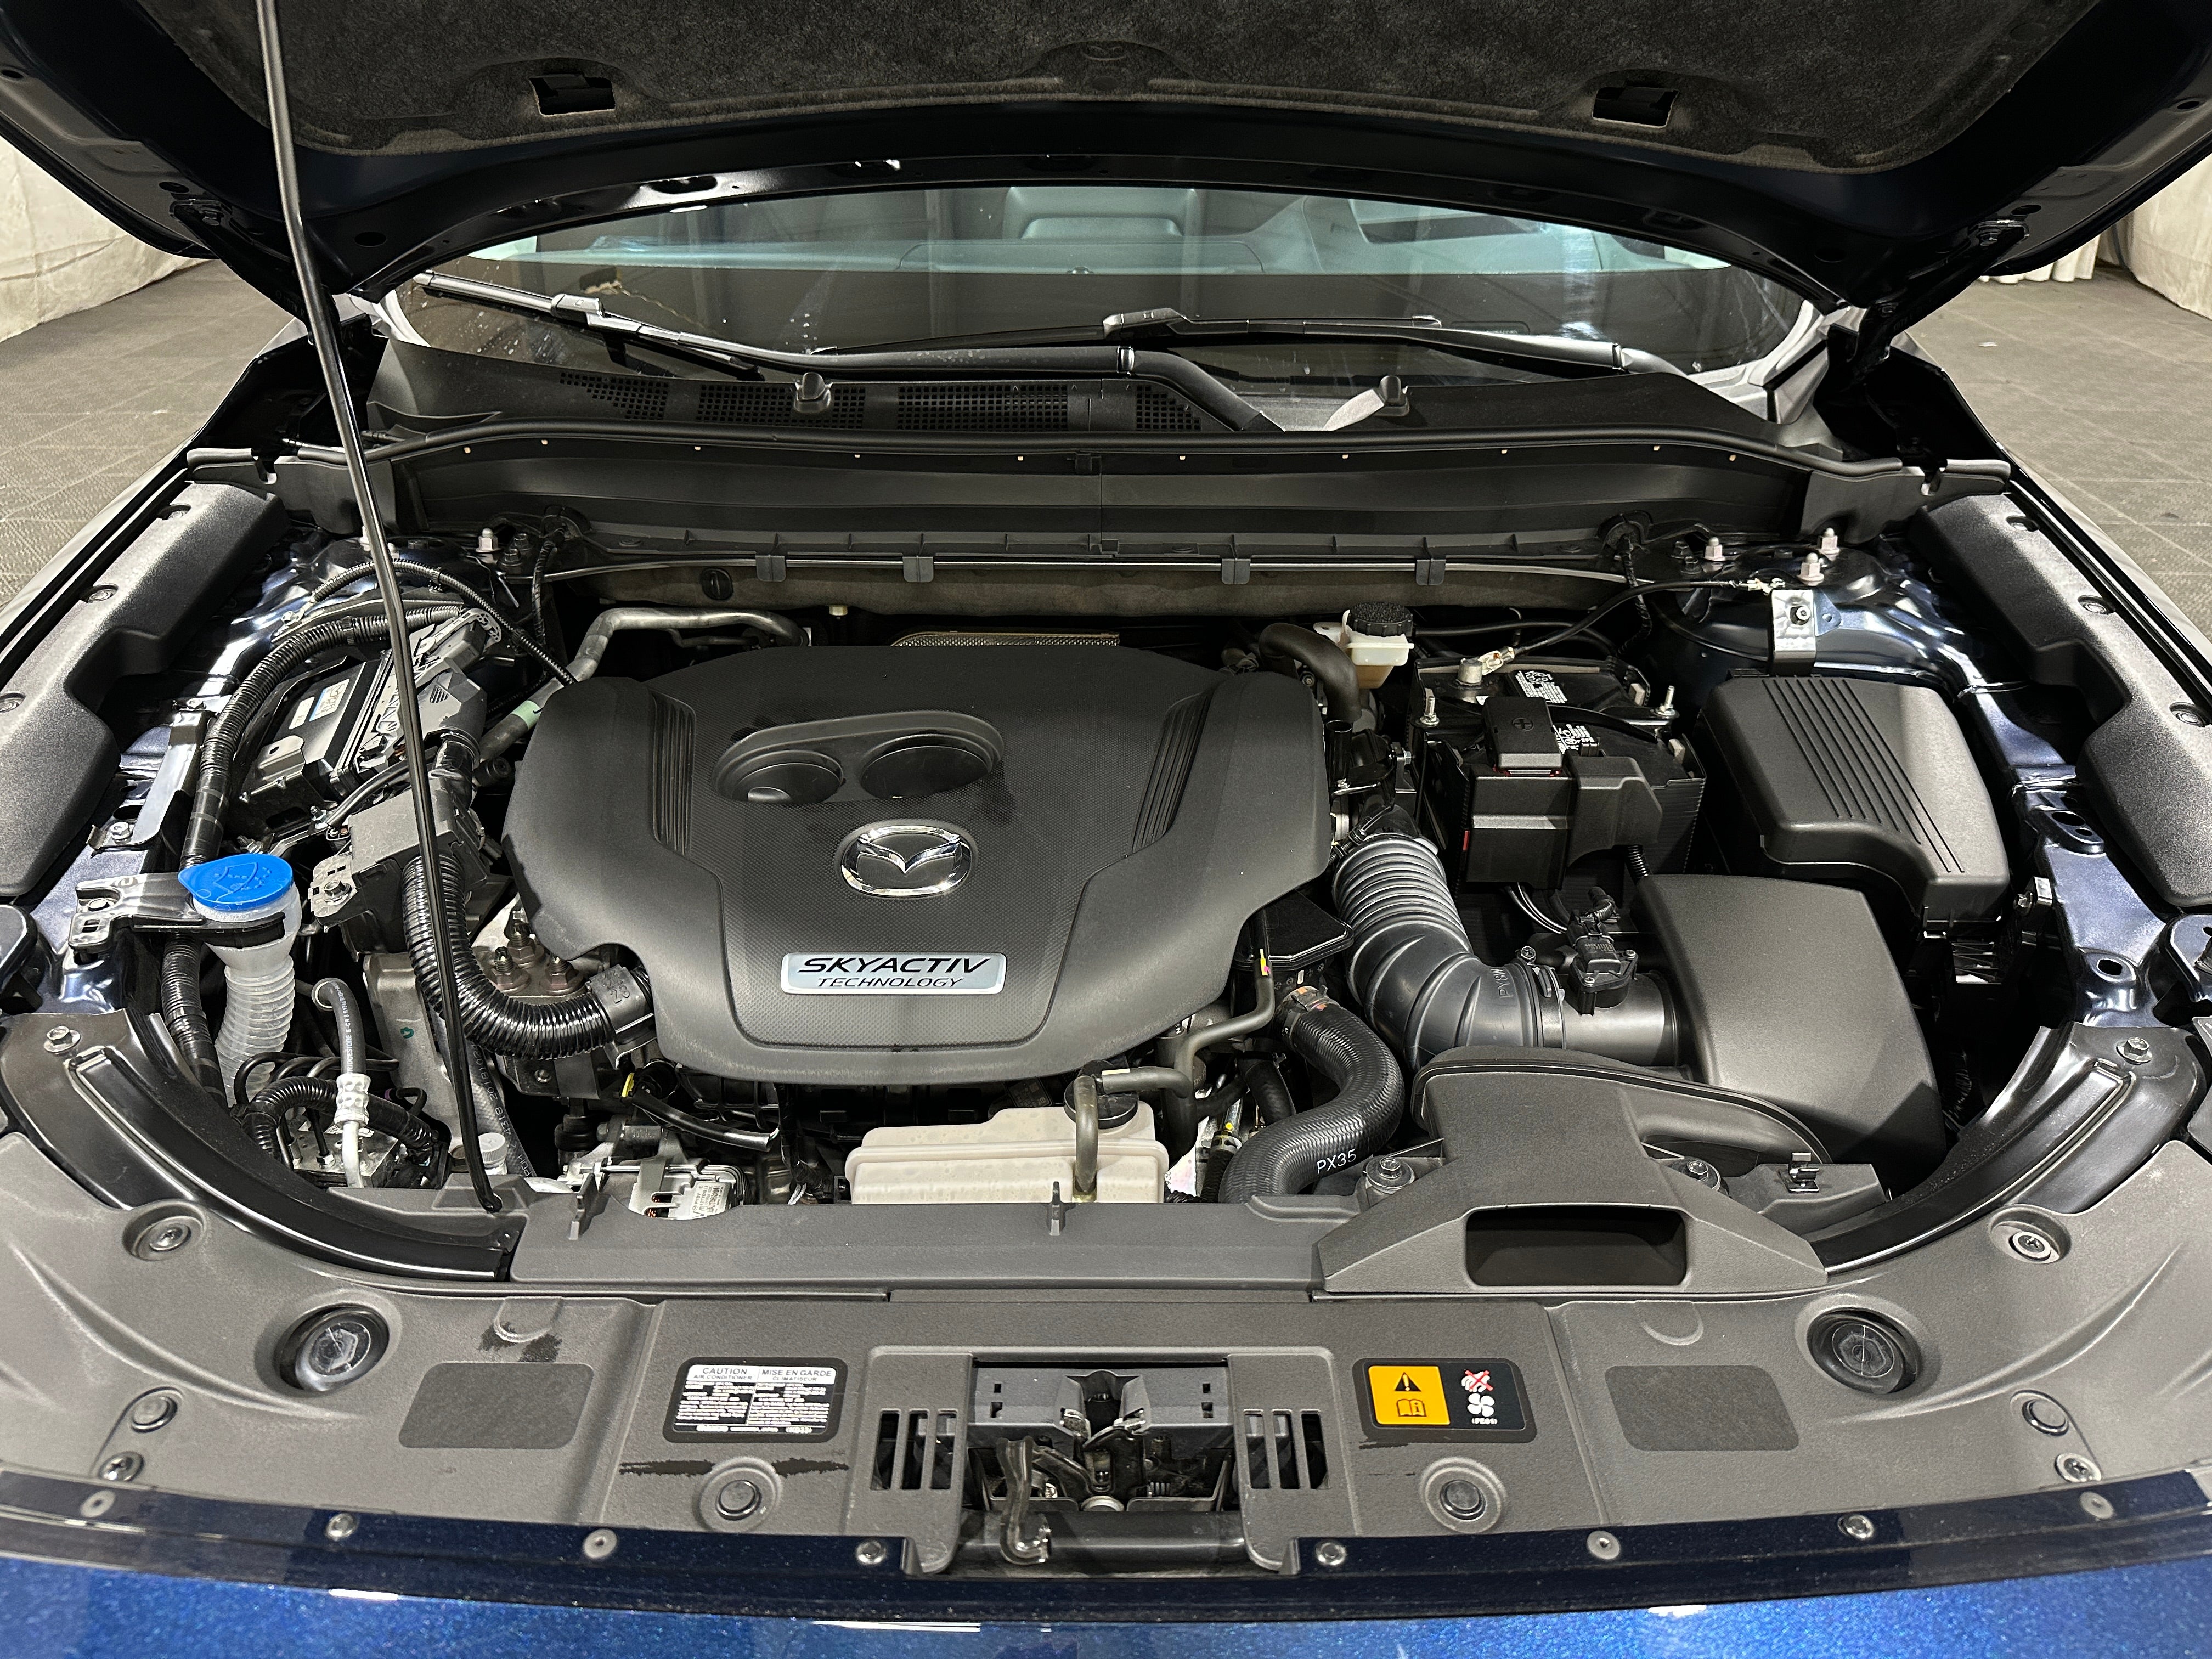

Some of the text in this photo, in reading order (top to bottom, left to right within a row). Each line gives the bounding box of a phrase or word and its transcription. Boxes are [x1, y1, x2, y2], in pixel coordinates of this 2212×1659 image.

[798, 957, 990, 973] SKYACTIV
[817, 978, 964, 987] TECHNOLOGY
[1492, 968, 1514, 998] PY8W
[346, 1035, 354, 1074] RIDGESTONE
[495, 1106, 512, 1135] 4318
[1317, 1148, 1357, 1175] PX35
